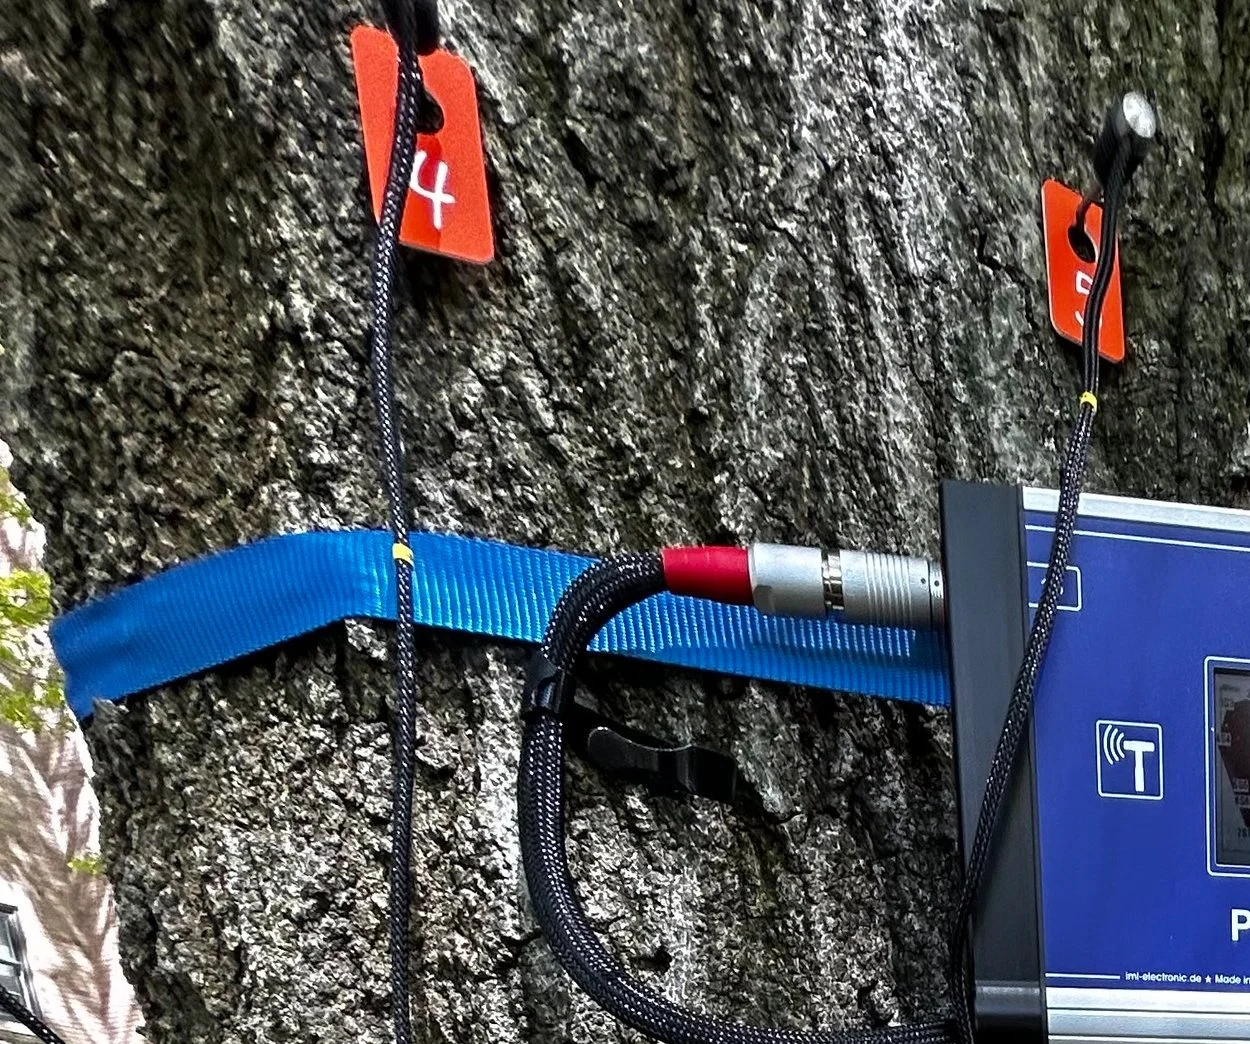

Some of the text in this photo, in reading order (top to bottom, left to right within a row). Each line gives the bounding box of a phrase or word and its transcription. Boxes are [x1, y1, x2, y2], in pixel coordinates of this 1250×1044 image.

[409, 149, 456, 230] 4
[1215, 974, 1241, 984] Made
[1243, 975, 1250, 985] in
